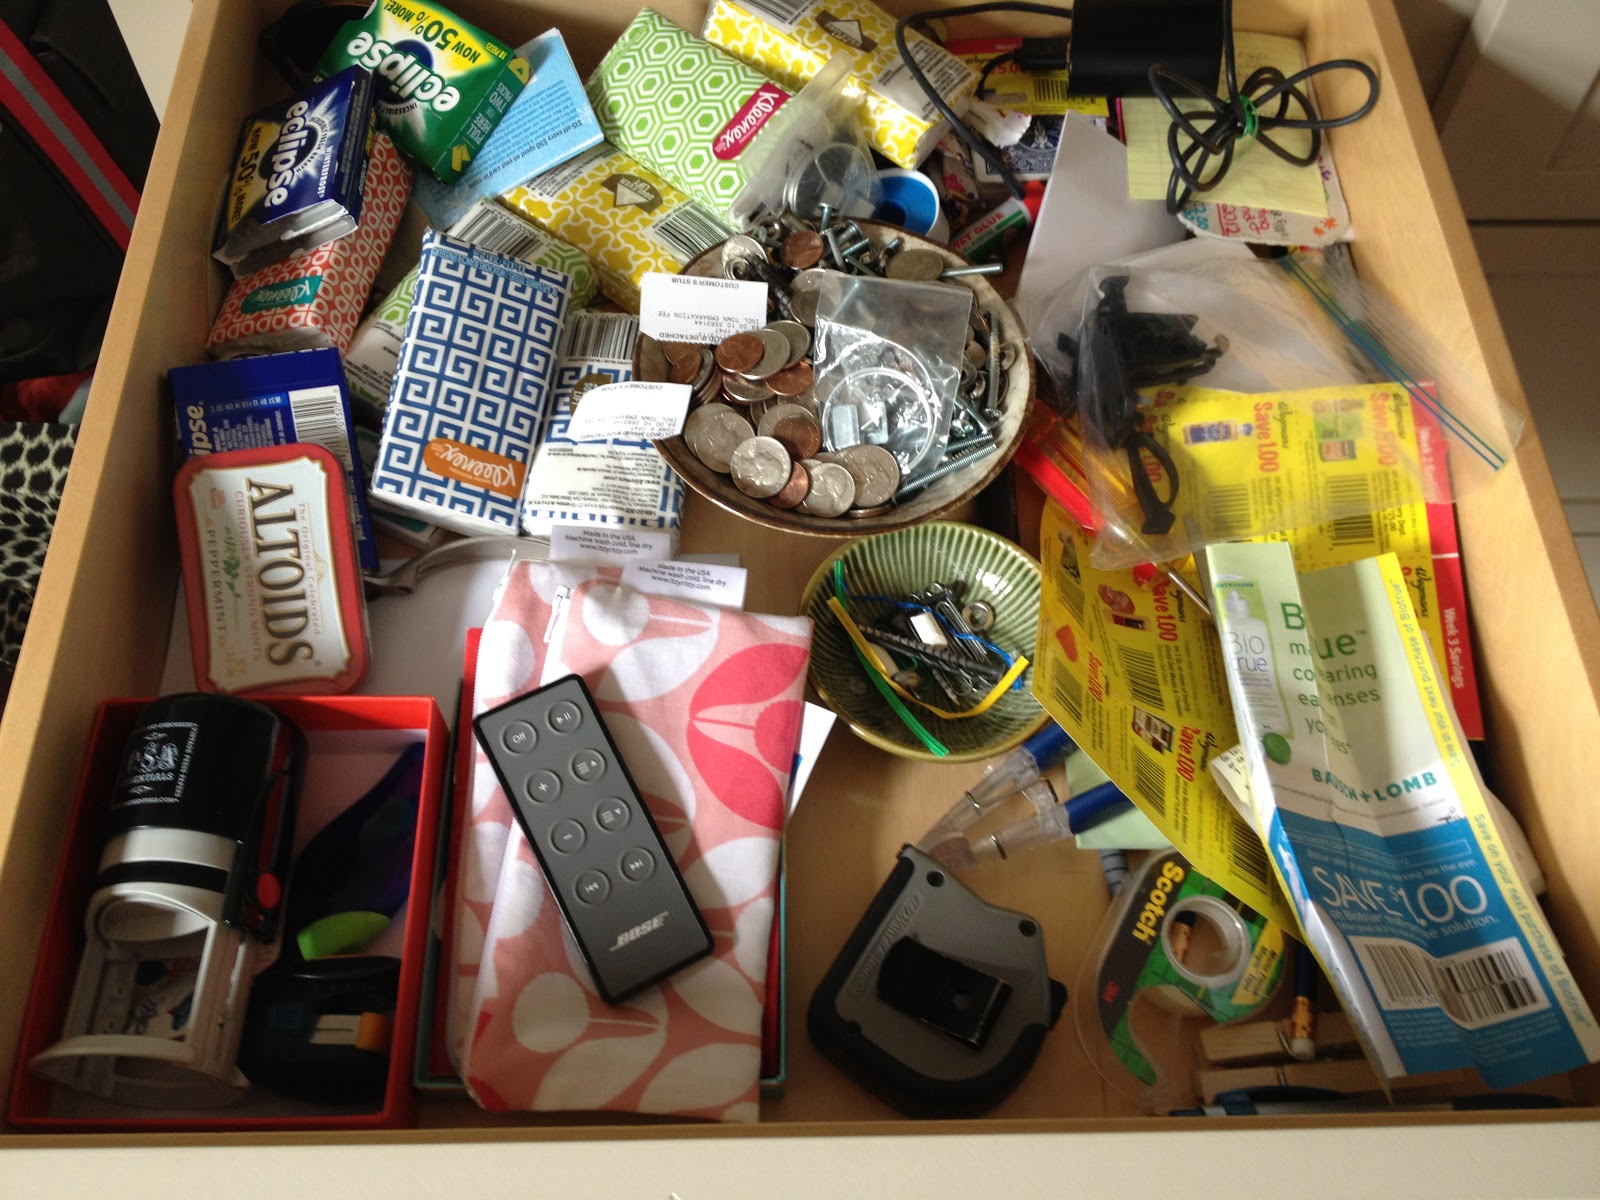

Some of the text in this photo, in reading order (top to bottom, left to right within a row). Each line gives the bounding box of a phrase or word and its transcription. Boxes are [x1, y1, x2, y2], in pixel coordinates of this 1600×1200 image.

[384, 0, 481, 63] NOW 50% MORE!
[348, 31, 460, 112] eclipse
[487, 90, 508, 112] TWO
[496, 81, 514, 101] PACKS
[464, 123, 485, 144] PULL
[472, 111, 493, 133] HERE
[562, 125, 571, 134] off
[571, 119, 582, 129] $15
[719, 92, 782, 150] Kleenex
[248, 127, 261, 151] NOW
[535, 138, 547, 149] $50
[547, 129, 562, 141] every
[264, 100, 308, 207] eclipse
[296, 152, 317, 172] BREATH
[501, 157, 512, 168] your
[512, 152, 519, 160] on
[520, 143, 536, 156] spent
[233, 151, 259, 196] 50%
[488, 165, 500, 176] card
[255, 280, 310, 301] Kleenex
[692, 279, 739, 288] CUSTOMER'S
[673, 311, 719, 320] EMBARKATION
[659, 331, 698, 340] DETACHED
[1370, 392, 1392, 428] Save
[187, 403, 211, 457] ipse
[1252, 401, 1279, 473] Save 1.00
[1273, 402, 1292, 448] Wegmans
[439, 443, 515, 487] Kleenex
[234, 491, 249, 560] CURIOUSLY
[582, 529, 601, 537] Made
[564, 534, 592, 543] Machine
[611, 539, 625, 547] cold,
[245, 478, 313, 665] ALTOIDS
[298, 503, 320, 635] The Original Celebrated
[639, 565, 666, 576] Machine
[667, 571, 684, 580] wash
[716, 579, 726, 587] dry
[658, 563, 676, 571] Made
[205, 529, 226, 632] PEPPERMINT
[1410, 566, 1431, 617] Wegmans
[1169, 587, 1185, 622] egmans
[1155, 612, 1179, 641] 1.00
[1443, 608, 1457, 637] Week
[1409, 636, 1431, 681] purchase
[1448, 646, 1465, 689] Savings
[1424, 684, 1438, 707] next
[1434, 711, 1449, 728] your
[511, 730, 527, 744] Off
[1199, 732, 1217, 772] Wegmans
[1175, 753, 1193, 781] 1.00
[1312, 865, 1403, 916] SAVE
[1473, 812, 1491, 841] Save
[1492, 860, 1512, 884] your
[1508, 887, 1526, 911] next
[1520, 912, 1553, 962] purchase
[1130, 860, 1187, 944] Scotch
[609, 910, 669, 951] BOSE
[1442, 914, 1498, 934] solution.
